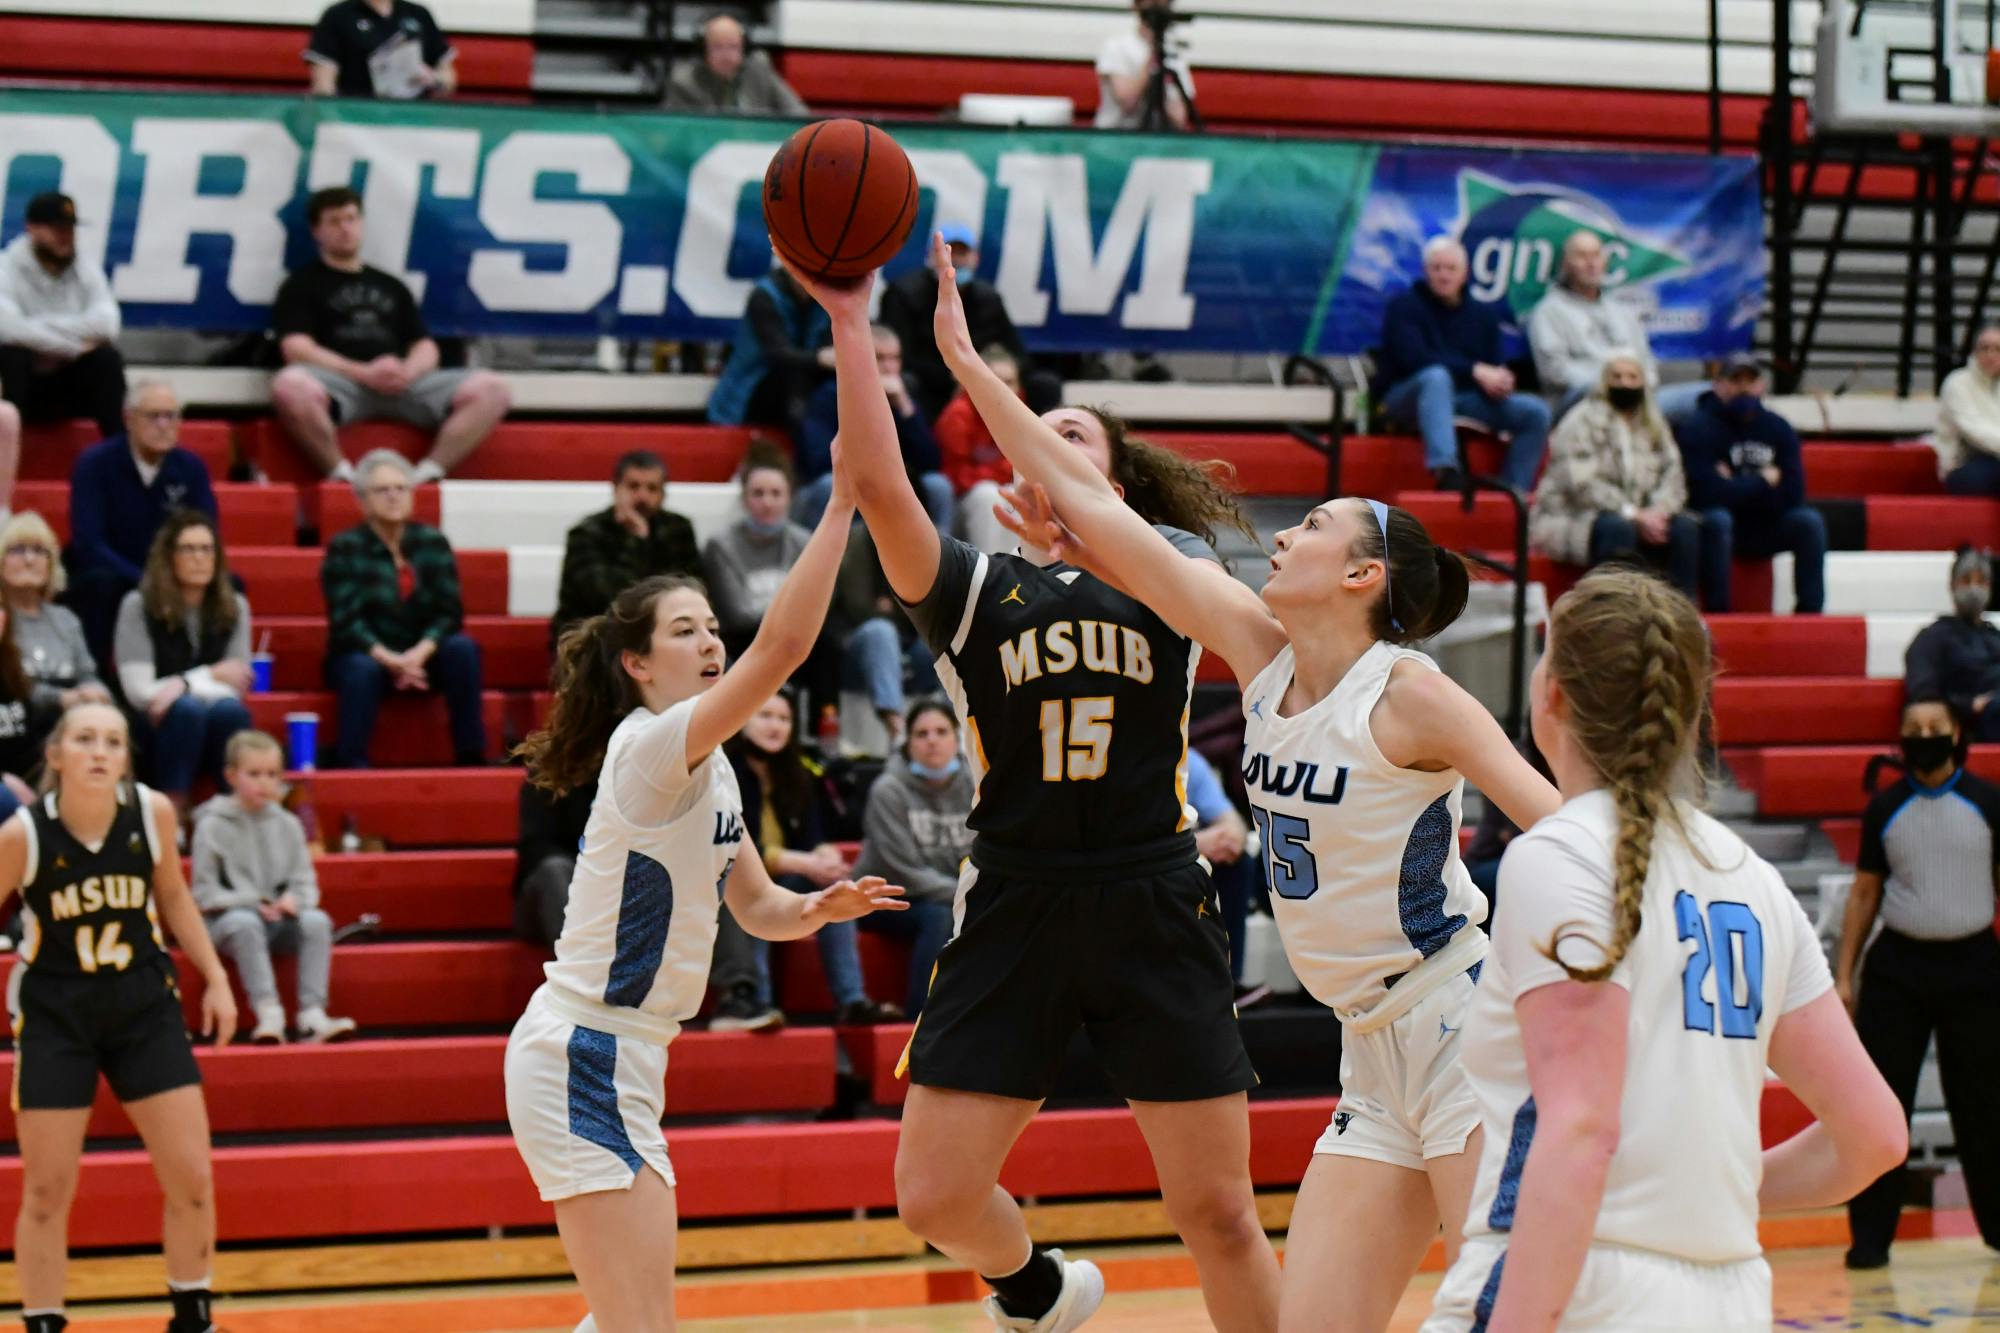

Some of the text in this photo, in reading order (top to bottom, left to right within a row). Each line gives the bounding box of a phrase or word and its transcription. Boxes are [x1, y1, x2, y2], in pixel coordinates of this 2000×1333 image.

[1469, 236, 1628, 302] gnc
[998, 620, 1154, 695] MSUB
[1039, 695, 1115, 782] 15
[1250, 803, 1319, 900] 15
[50, 874, 146, 921] MSUB
[75, 921, 133, 973] 14
[1673, 889, 1764, 1040] 20
